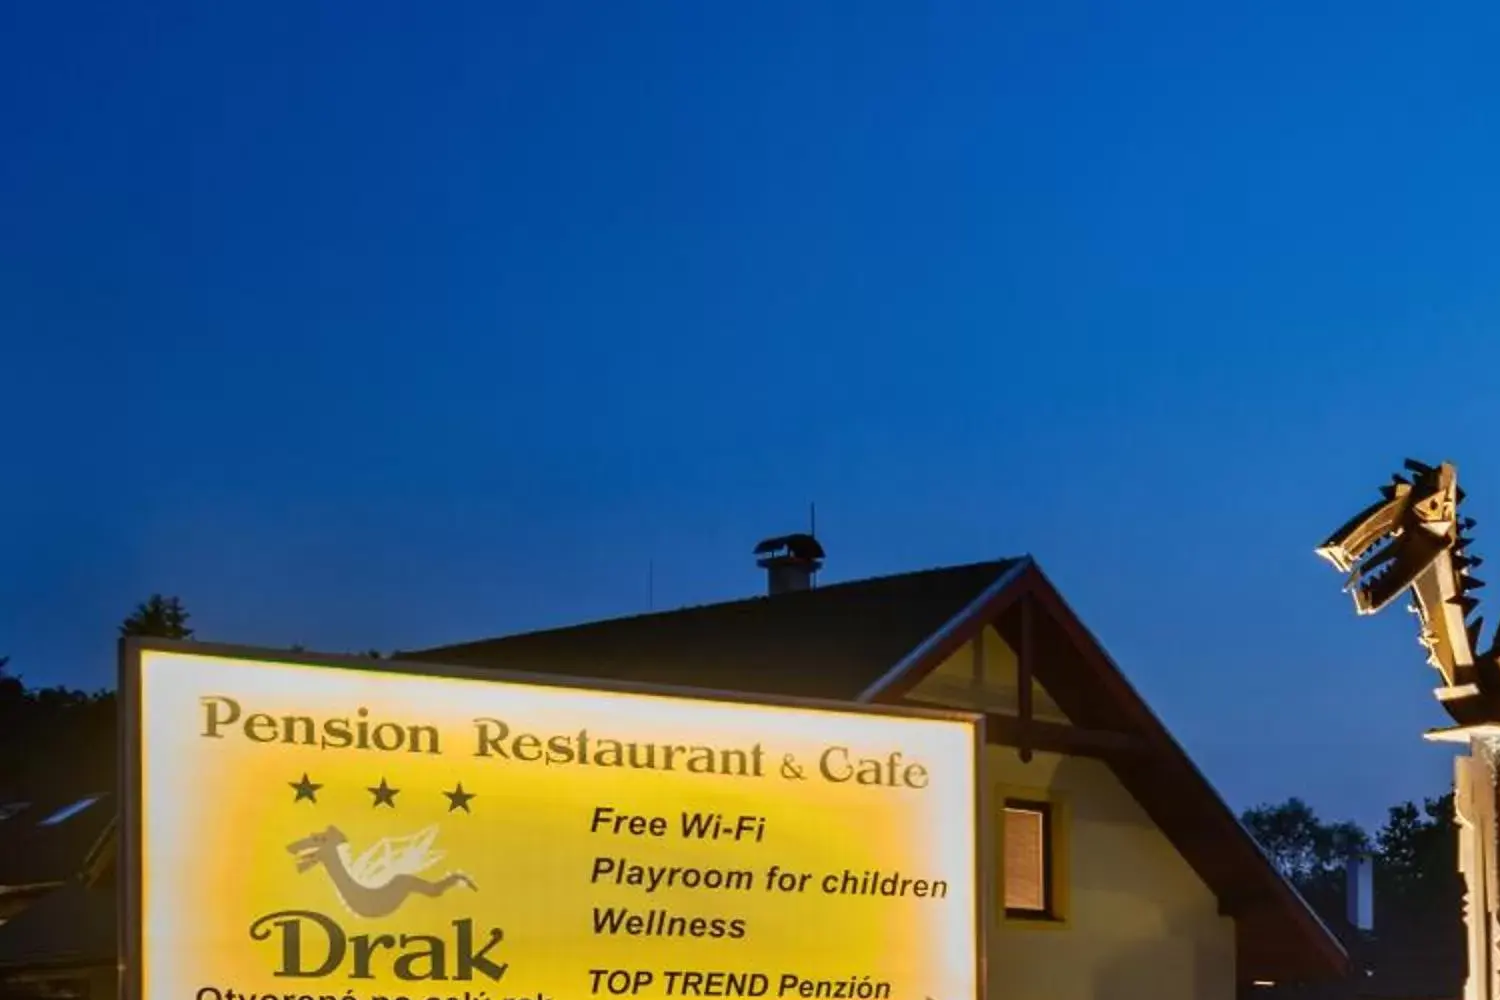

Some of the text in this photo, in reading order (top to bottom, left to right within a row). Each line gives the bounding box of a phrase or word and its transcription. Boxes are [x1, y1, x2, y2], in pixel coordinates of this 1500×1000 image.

[199, 695, 442, 755] Pension
[472, 717, 764, 777] Restaurant
[780, 752, 807, 781] &
[590, 807, 766, 842] Free Wi-Fi
[590, 857, 948, 898] Playroom for children
[592, 908, 746, 939] Wellness
[249, 910, 509, 982] Drak
[588, 970, 891, 1000] TOP TREND Penzión
